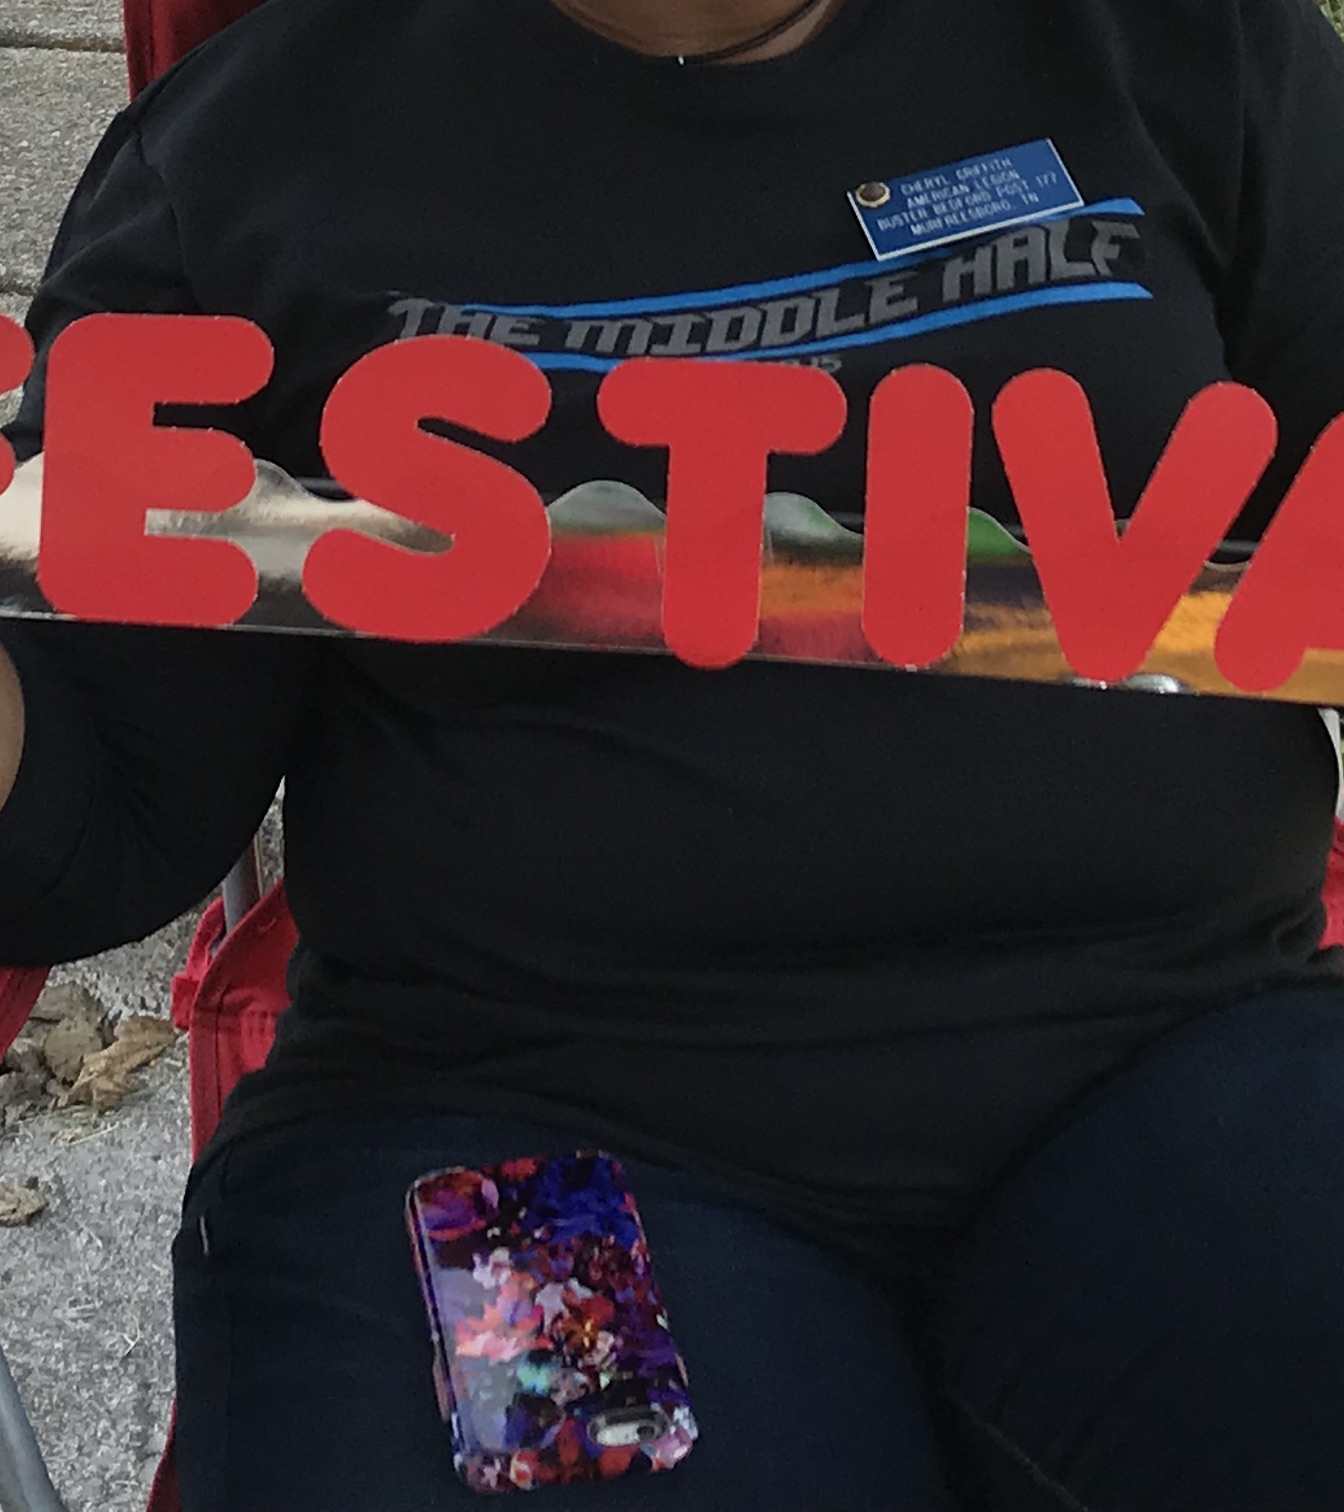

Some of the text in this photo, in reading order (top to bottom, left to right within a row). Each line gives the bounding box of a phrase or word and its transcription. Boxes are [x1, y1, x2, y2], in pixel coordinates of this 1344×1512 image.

[907, 183, 970, 209] AMERICAN
[388, 220, 1140, 356] THE MIDDLE HALF
